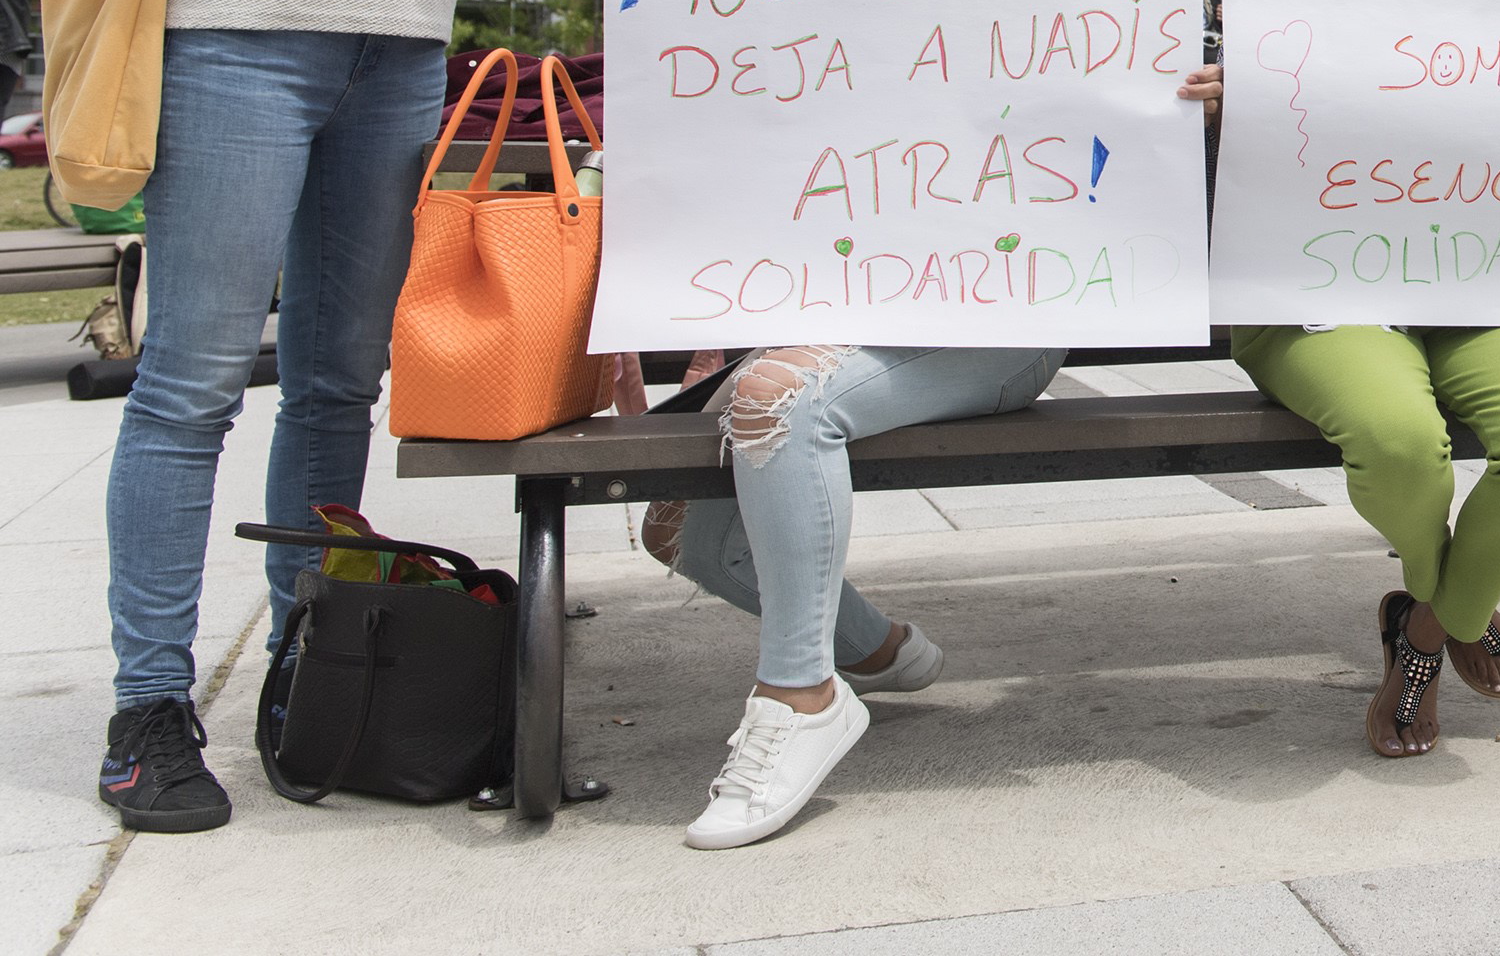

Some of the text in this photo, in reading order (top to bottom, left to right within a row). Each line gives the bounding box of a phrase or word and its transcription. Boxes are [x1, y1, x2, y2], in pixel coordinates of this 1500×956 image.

[658, 32, 854, 102] DEJA
[907, 23, 949, 83] A
[793, 105, 1110, 221] ATRÁS!
